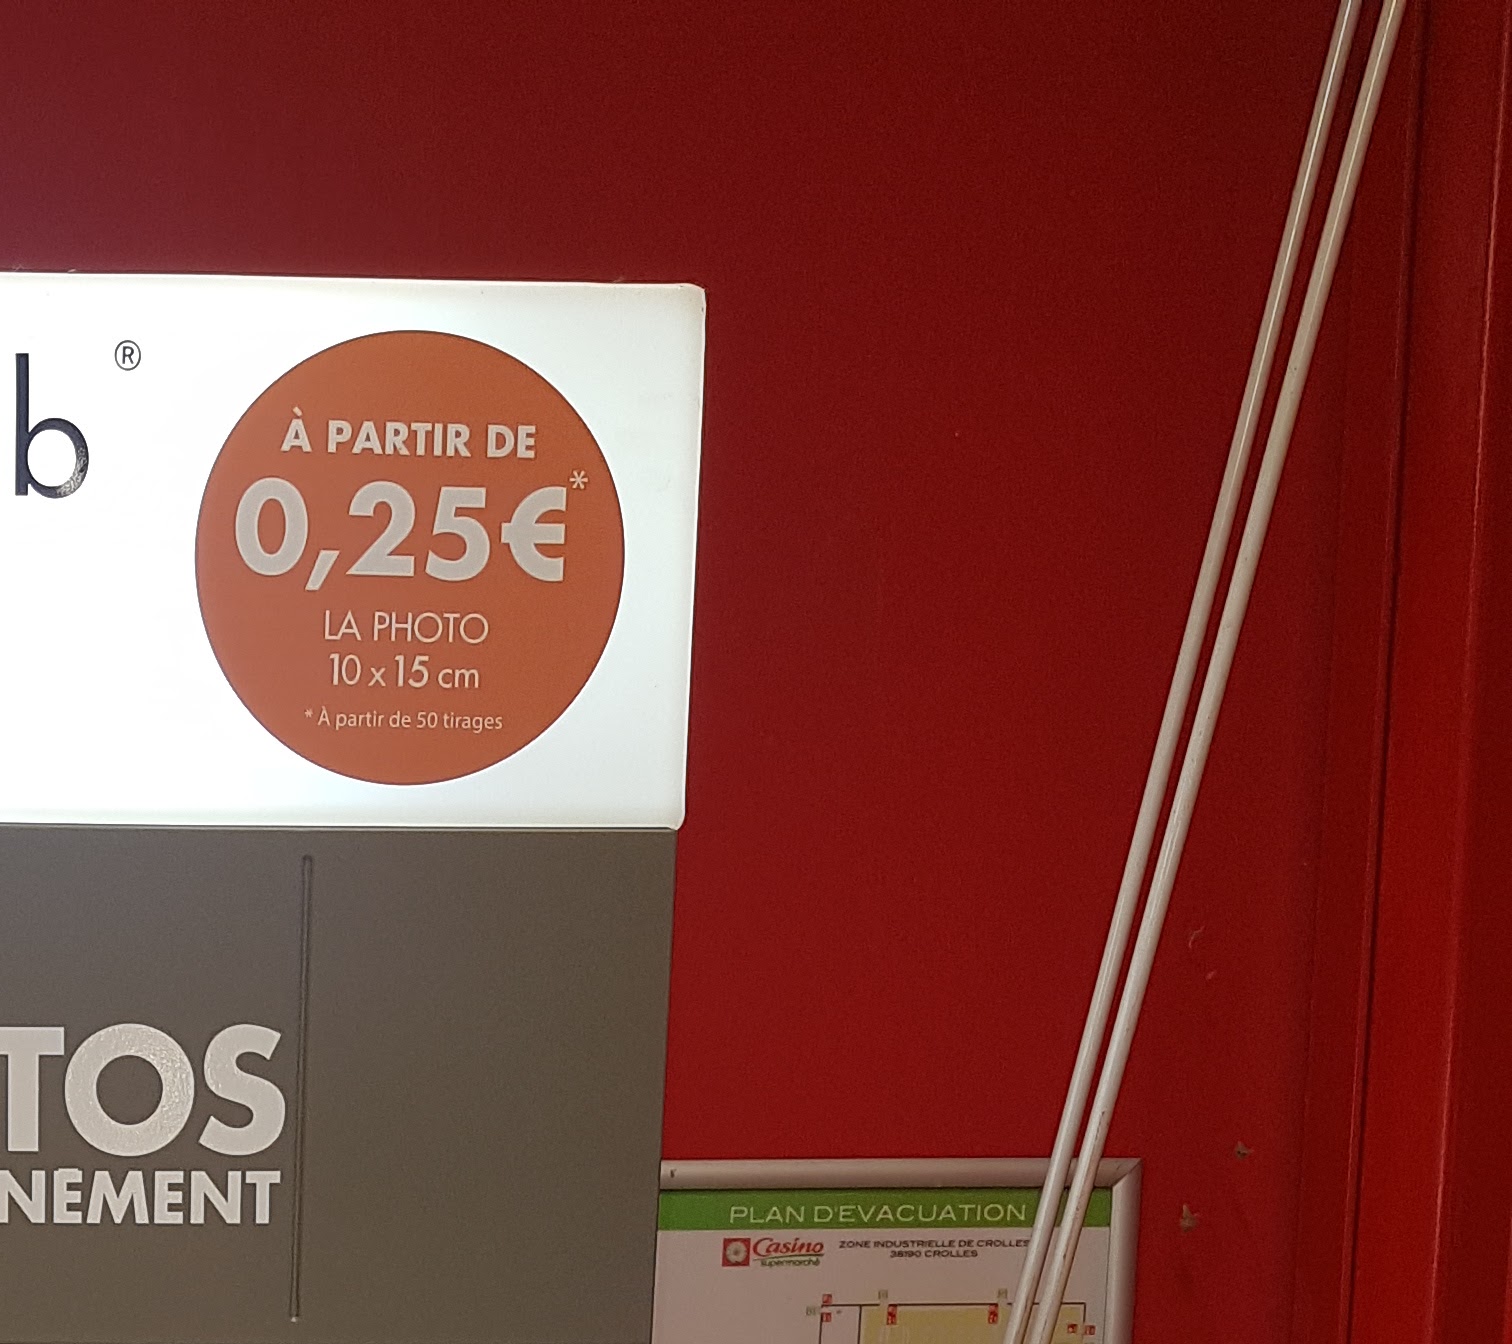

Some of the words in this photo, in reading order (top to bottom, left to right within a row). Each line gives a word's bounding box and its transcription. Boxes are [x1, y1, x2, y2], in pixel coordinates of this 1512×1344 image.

[281, 407, 312, 452] À
[327, 420, 472, 458] PARTIR
[486, 424, 536, 458] DE
[324, 610, 362, 641] LA
[373, 611, 489, 644] PHOTO
[329, 653, 362, 686] 10
[368, 667, 386, 687] x
[394, 654, 429, 688] 15
[438, 667, 479, 688] cm
[336, 711, 384, 731] partir
[389, 711, 411, 728] de
[416, 712, 438, 728] 50
[443, 712, 503, 734] tirages
[729, 1205, 804, 1223] PLAN
[753, 1237, 824, 1254] Casino
[839, 1240, 871, 1249] ZONE
[873, 1239, 956, 1249] INDUSTRIELLE
[958, 1239, 974, 1248] DE
[976, 1239, 1030, 1248] CROLLES
[924, 1249, 978, 1258] CROLLES
